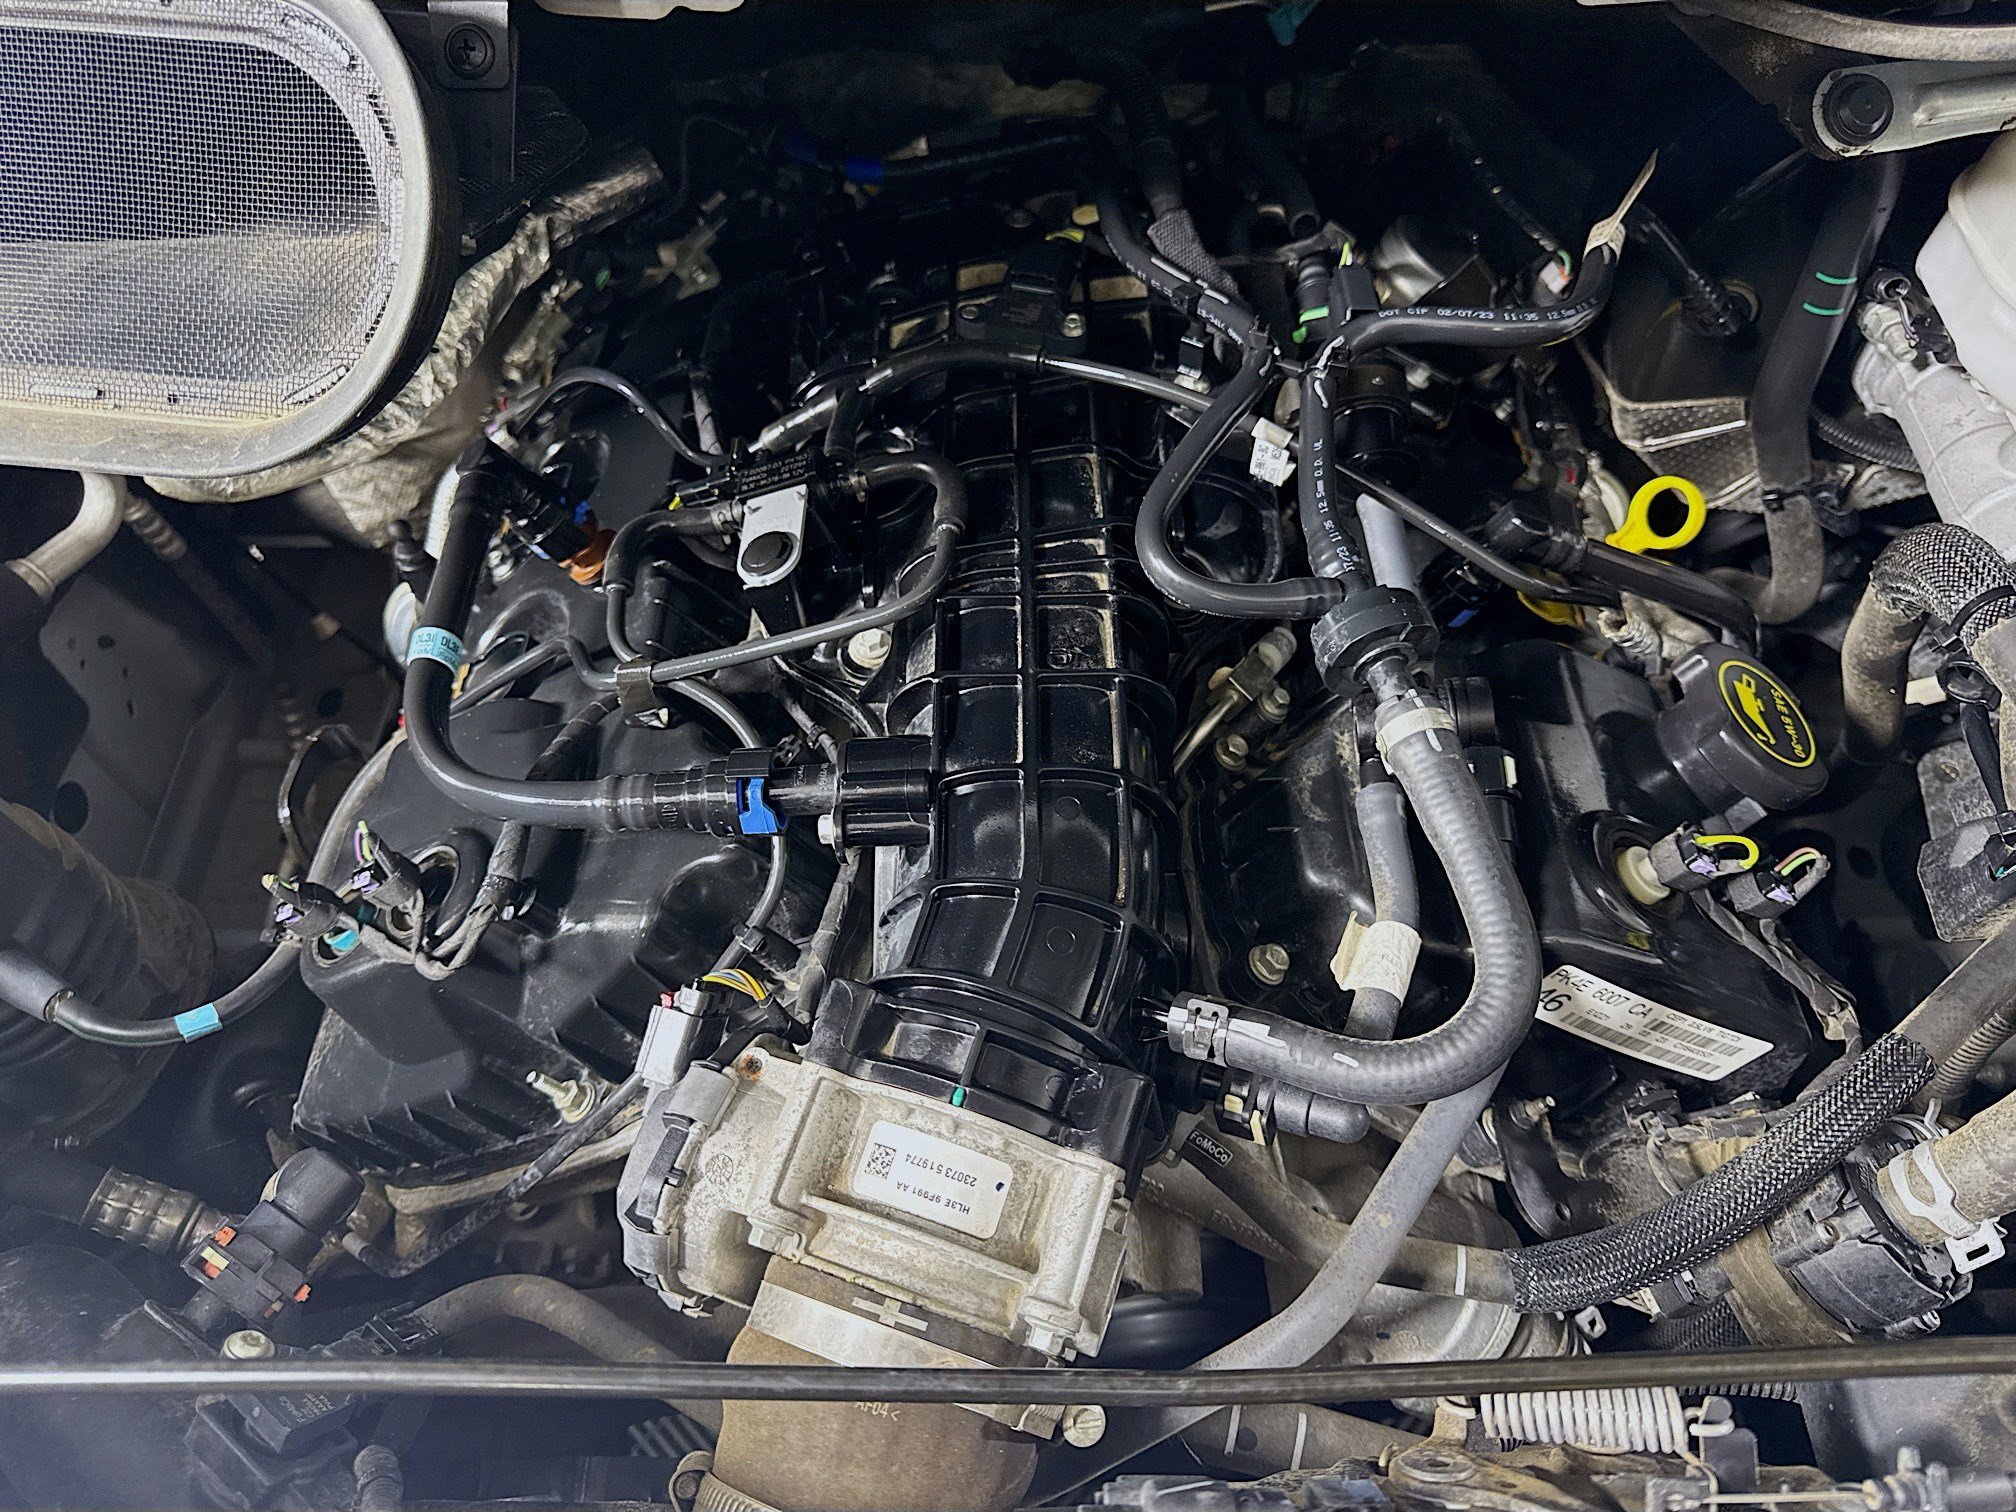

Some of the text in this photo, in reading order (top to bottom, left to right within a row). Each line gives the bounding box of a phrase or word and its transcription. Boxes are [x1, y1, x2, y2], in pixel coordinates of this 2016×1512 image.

[1378, 308, 1400, 319] DOT
[1436, 308, 1495, 320] 02/07/23
[1502, 311, 1539, 321] 11:35
[1323, 519, 1342, 542] 11:35
[1770, 688, 1789, 715] SAE
[1551, 968, 1654, 1019] PK4E 6007 CA
[1190, 1131, 1228, 1162] FoMoCo
[904, 1153, 978, 1188] 23073 519774
[896, 1180, 971, 1215] HL3E 9F991 AA
[279, 1395, 305, 1422] FoMoCo
